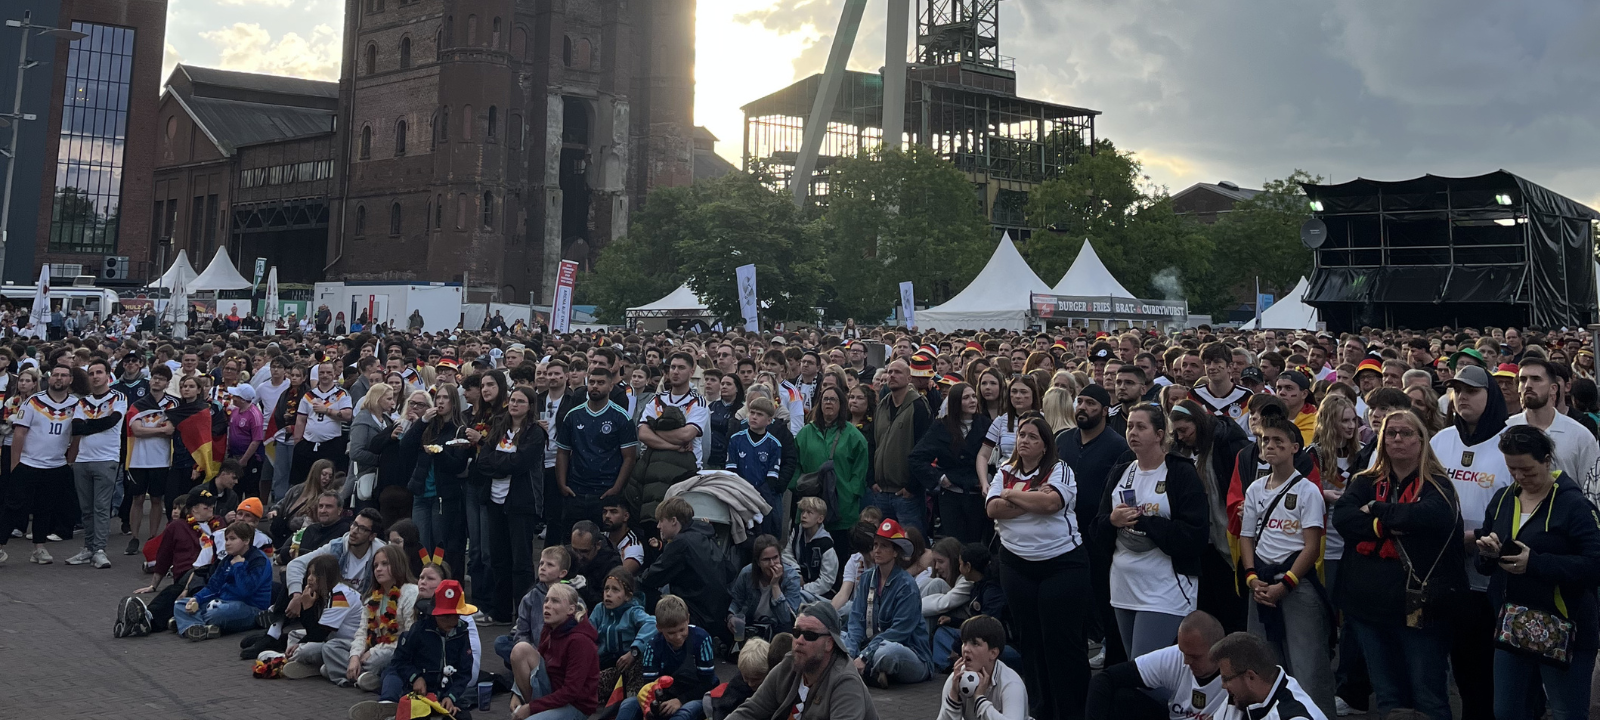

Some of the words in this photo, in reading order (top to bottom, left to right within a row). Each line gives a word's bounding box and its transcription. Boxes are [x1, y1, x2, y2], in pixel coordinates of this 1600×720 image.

[1058, 301, 1087, 312] BURGER
[1093, 302, 1111, 312] FRIES
[1115, 303, 1136, 313] BRAT-
[1142, 305, 1184, 316] CURRYWURST
[48, 422, 63, 435] 10
[1444, 468, 1495, 486] HECK24
